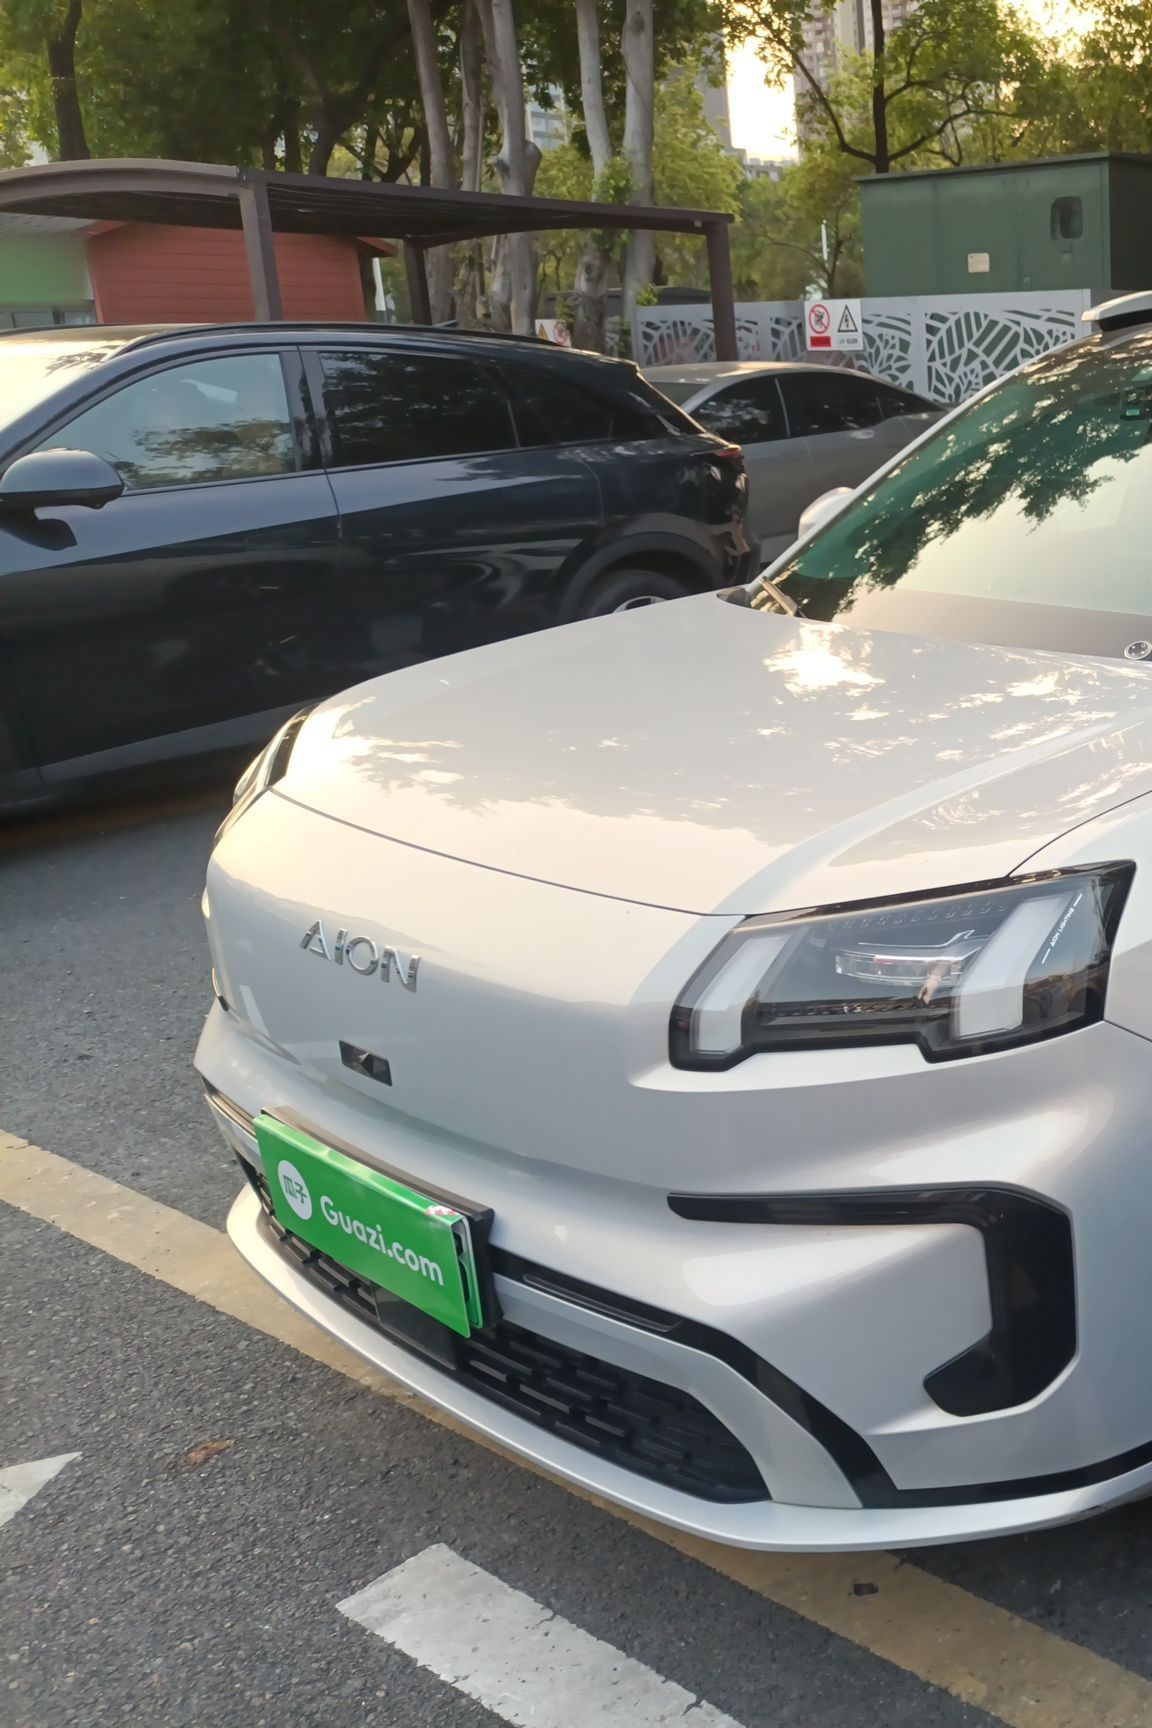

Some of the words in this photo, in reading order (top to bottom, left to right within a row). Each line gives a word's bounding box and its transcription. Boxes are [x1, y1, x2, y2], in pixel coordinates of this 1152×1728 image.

[300, 919, 422, 993] AION
[282, 1174, 307, 1204] 瓜子
[320, 1195, 444, 1287] Guazi.com
